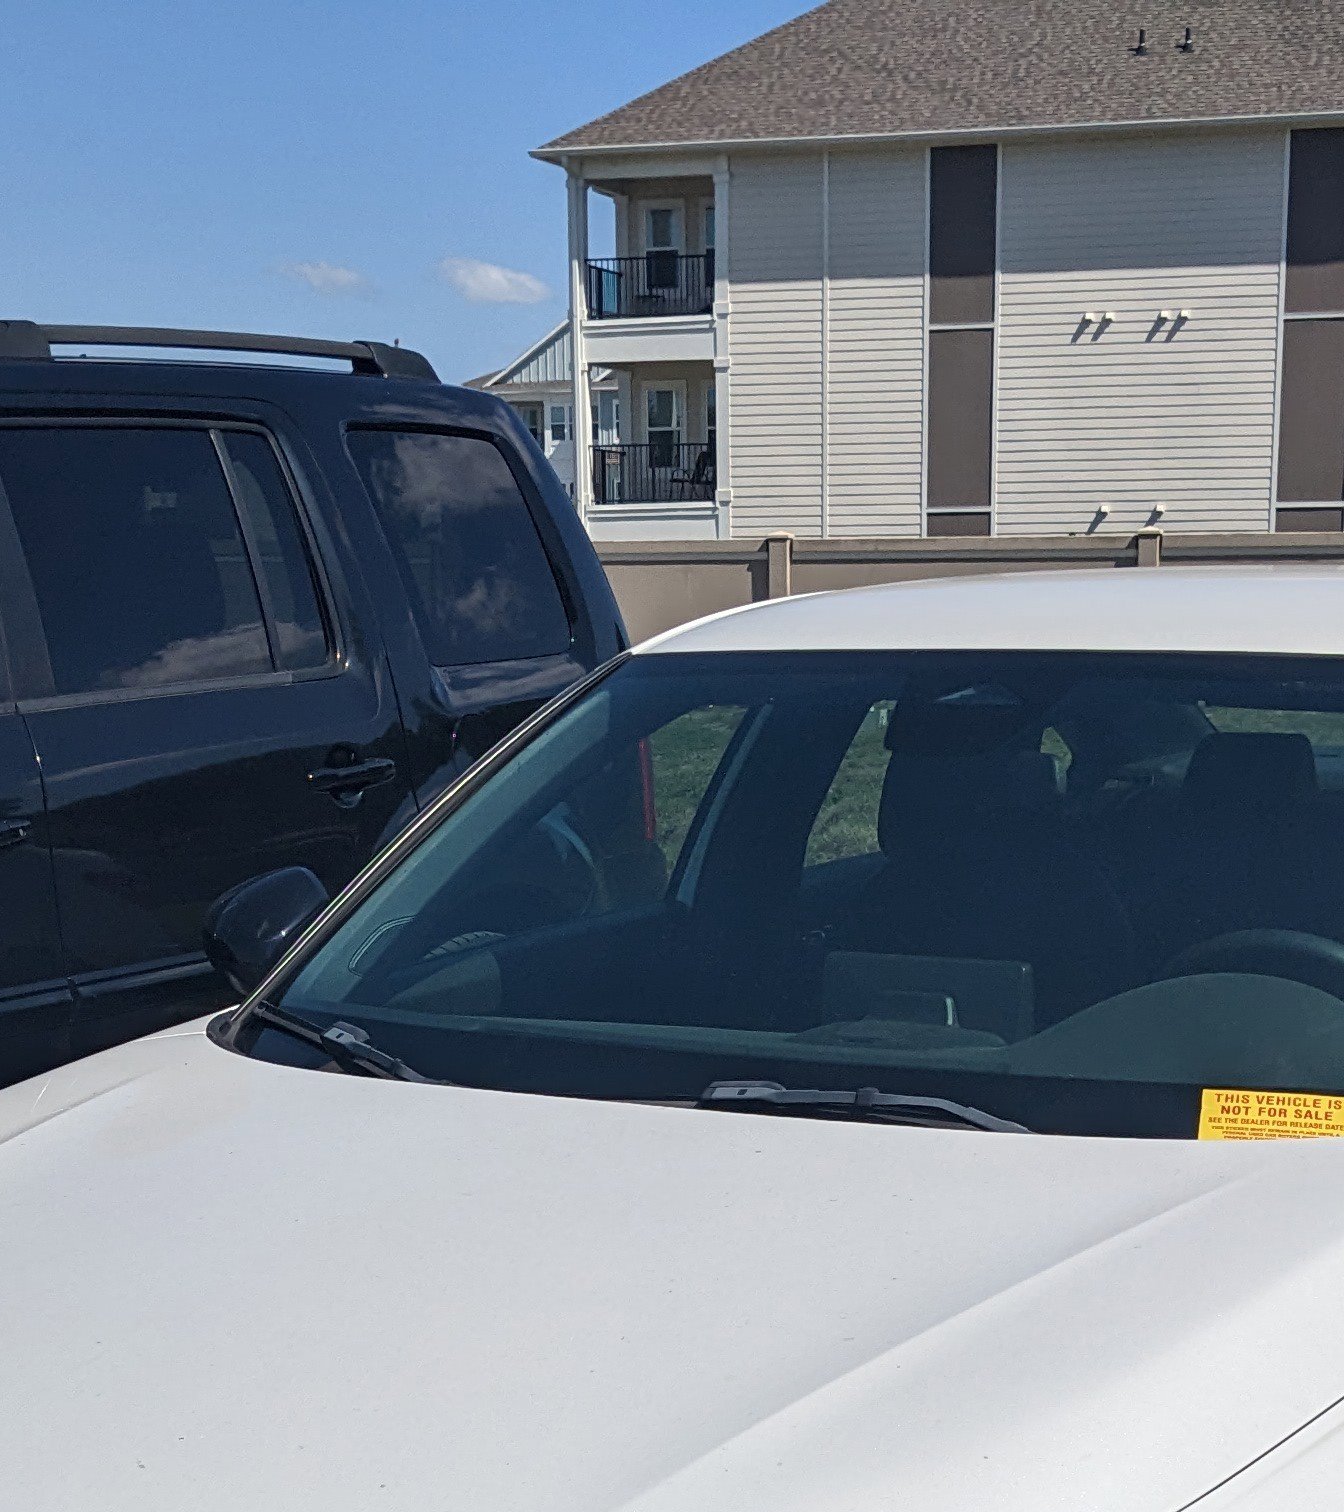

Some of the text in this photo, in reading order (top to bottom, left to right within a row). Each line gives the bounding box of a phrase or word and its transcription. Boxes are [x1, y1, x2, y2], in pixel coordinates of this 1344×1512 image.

[1214, 1093, 1343, 1110] THIS VEHICLE IS
[1220, 1105, 1333, 1121] NOT FOR SALE
[1207, 1116, 1223, 1124] SEE
[1240, 1118, 1270, 1126] DEALER
[1290, 1121, 1323, 1130] RELEASE
